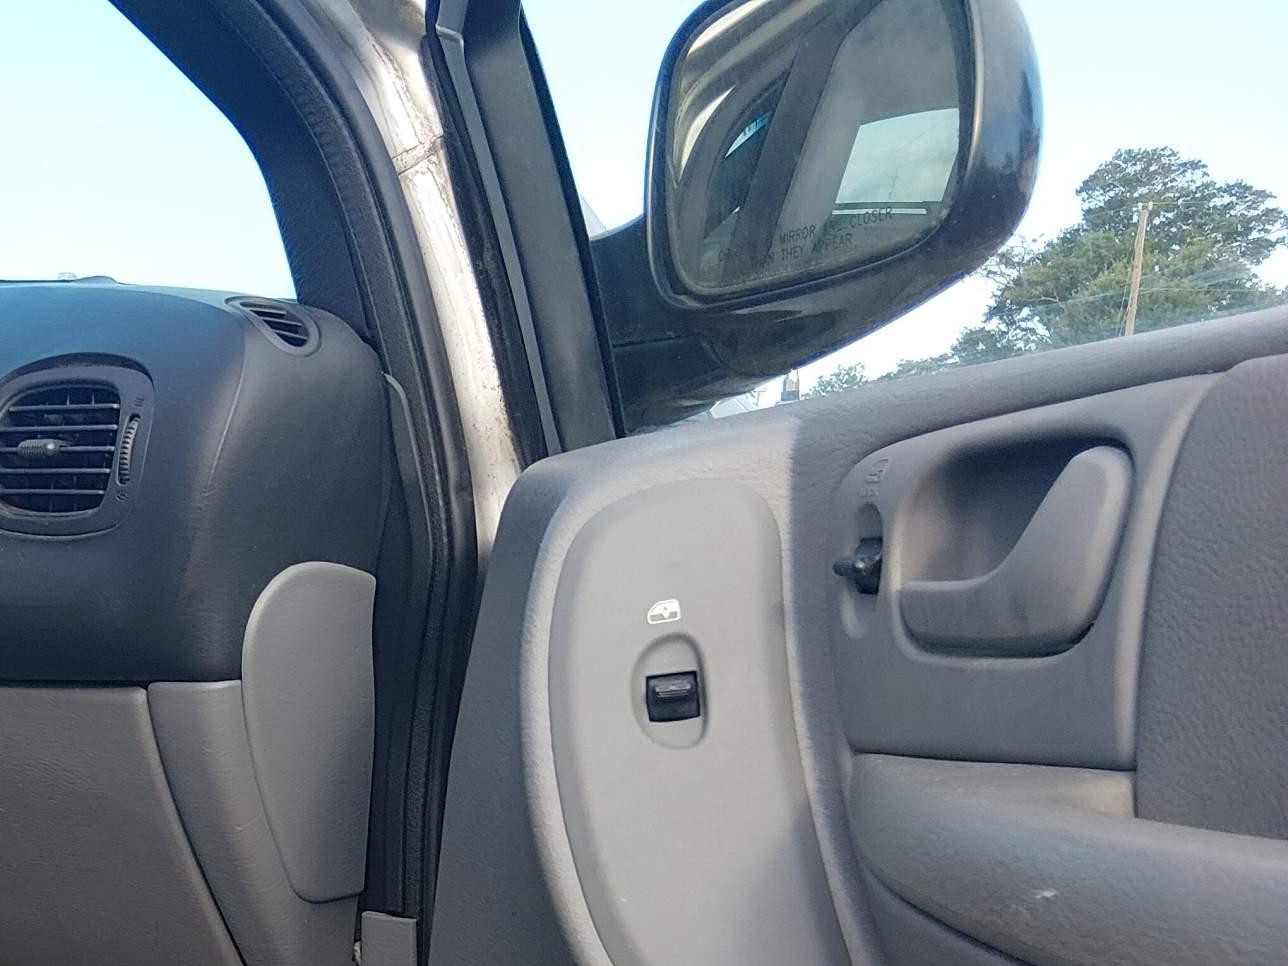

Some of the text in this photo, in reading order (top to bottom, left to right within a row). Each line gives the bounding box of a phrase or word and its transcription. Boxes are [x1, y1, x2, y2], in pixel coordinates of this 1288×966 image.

[779, 224, 816, 243] MIRROR
[850, 206, 893, 228] CLOSER
[781, 245, 804, 261] THEY
[812, 232, 853, 255] APPEAR
